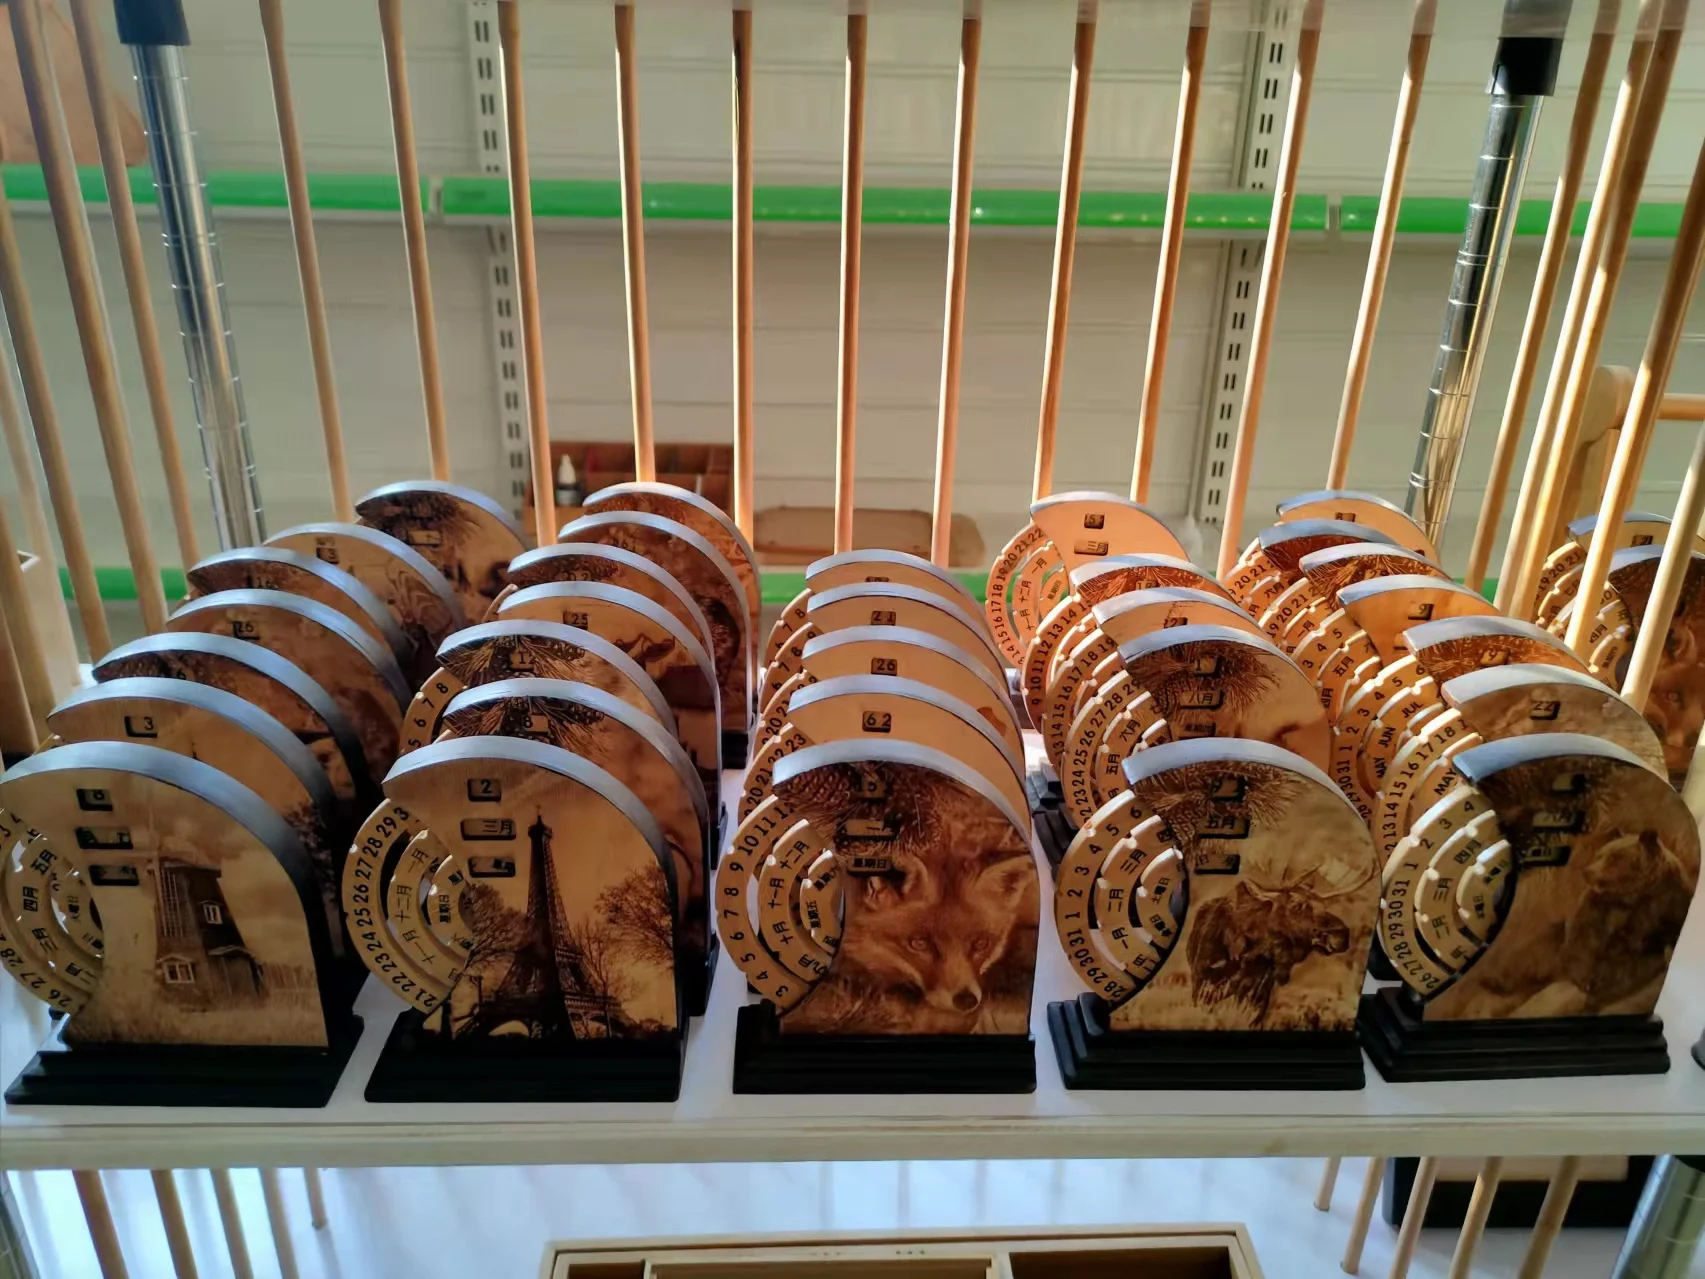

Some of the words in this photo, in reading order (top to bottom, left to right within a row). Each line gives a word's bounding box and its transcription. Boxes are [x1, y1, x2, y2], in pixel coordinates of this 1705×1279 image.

[1028, 527, 1044, 543] 22
[1014, 540, 1030, 554] 21
[1003, 552, 1017, 569] 20
[1031, 557, 1047, 574] 一月
[1565, 551, 1583, 567] 21
[997, 566, 1010, 582] 19
[1250, 564, 1266, 579] 21
[1549, 563, 1565, 578] 20
[1235, 574, 1250, 589] 20
[993, 584, 1003, 598] 18
[1019, 580, 1032, 603] 十二月
[991, 601, 1002, 613] 17
[1291, 593, 1309, 611] 21
[794, 608, 806, 619] 8
[1019, 608, 1035, 631] 十一月
[1060, 608, 1077, 625] 14
[1276, 606, 1293, 624] 20
[992, 616, 1004, 629] 16
[1266, 622, 1279, 639] 19
[1298, 619, 1316, 637] 一月
[1047, 623, 1064, 640] 13
[1333, 627, 1344, 639] 5
[1038, 639, 1053, 657] 12
[1098, 637, 1116, 653] 19
[1316, 642, 1327, 652] 4
[779, 661, 790, 673] 7
[876, 659, 896, 671] 26
[1031, 659, 1046, 674] 11
[1081, 651, 1099, 668] 18
[1302, 659, 1314, 669] 3
[1332, 655, 1355, 678] 五月
[1067, 666, 1083, 684] 17
[1416, 666, 1425, 675] 6
[436, 682, 449, 694] 8
[1030, 676, 1042, 691] 10
[1391, 676, 1403, 687] 5
[1058, 686, 1074, 701] 16
[1104, 692, 1124, 711] 28
[1374, 691, 1386, 700] 4
[422, 699, 435, 709] 7
[1052, 704, 1066, 719] 15
[1357, 707, 1370, 717] 3
[1401, 701, 1424, 719] JUL
[143, 716, 154, 731] 3
[413, 718, 427, 728] 6
[765, 717, 783, 736] 20
[1090, 709, 1107, 728] 27
[1051, 724, 1063, 738] 14
[1080, 729, 1096, 747] 26
[1120, 719, 1141, 742] 六月
[1346, 726, 1360, 734] 2
[1377, 726, 1397, 749] JUN
[1434, 726, 1456, 744] 18
[1052, 742, 1064, 756] 13
[1073, 749, 1089, 766] 25
[1415, 741, 1434, 760] 17
[1105, 753, 1121, 775] 五月
[1336, 760, 1350, 774] 31
[1373, 757, 1388, 779] MAY
[1400, 762, 1420, 778] 16
[480, 779, 493, 794] 2
[1072, 770, 1085, 786] 24
[1433, 768, 1457, 796] MAY
[1073, 789, 1088, 806] 23
[1388, 780, 1408, 798] 15
[1130, 806, 1142, 819] 6
[1383, 802, 1400, 819] 14
[1463, 801, 1475, 812] 4
[376, 816, 397, 838] 29
[483, 819, 513, 834] 三月
[753, 816, 777, 837] 11
[1106, 824, 1119, 837] 5
[1382, 822, 1396, 840] 13
[1440, 818, 1452, 830] 3
[362, 836, 383, 858] 28
[738, 834, 760, 856] 10
[1088, 843, 1102, 855] 4
[1420, 838, 1434, 850] 2
[1453, 840, 1482, 865] 四月
[31, 849, 57, 875] 五月
[407, 848, 429, 873] 一月
[779, 840, 810, 870] 十二月
[1120, 849, 1147, 875] 三月
[354, 858, 373, 880] 27
[729, 861, 744, 873] 9
[1074, 866, 1090, 876] 3
[1403, 861, 1418, 870] 1
[352, 883, 369, 903] 26
[724, 887, 739, 897] 8
[767, 877, 785, 909] 十一月
[1067, 888, 1083, 898] 2
[1391, 880, 1410, 897] 31
[1432, 877, 1453, 902] 三月
[23, 886, 39, 912] 四月
[395, 885, 413, 923] 十二月
[1108, 888, 1124, 912] 二月
[354, 907, 374, 927] 25
[723, 908, 739, 919] 7
[1065, 911, 1081, 920] 1
[1388, 900, 1404, 920] 30
[772, 920, 794, 945] 十月
[1388, 923, 1405, 940] 29
[1431, 914, 1450, 939] 二月
[32, 927, 58, 953] 三月
[362, 931, 384, 951] 24
[730, 931, 745, 941] 6
[1067, 927, 1085, 947] 31
[1111, 927, 1129, 950] 一月
[402, 929, 436, 965] 十一月
[1393, 941, 1413, 959] 28
[375, 952, 397, 973] 23
[740, 952, 756, 963] 5
[1074, 948, 1094, 968] 30
[756, 970, 769, 980] 4
[1086, 967, 1109, 985] 29
[1403, 960, 1424, 976] 27
[20, 971, 46, 989] 27
[392, 972, 417, 992] 22
[1421, 973, 1440, 989] 26
[775, 985, 789, 998] 3
[1104, 980, 1127, 998] 28
[415, 988, 437, 1008] 21
